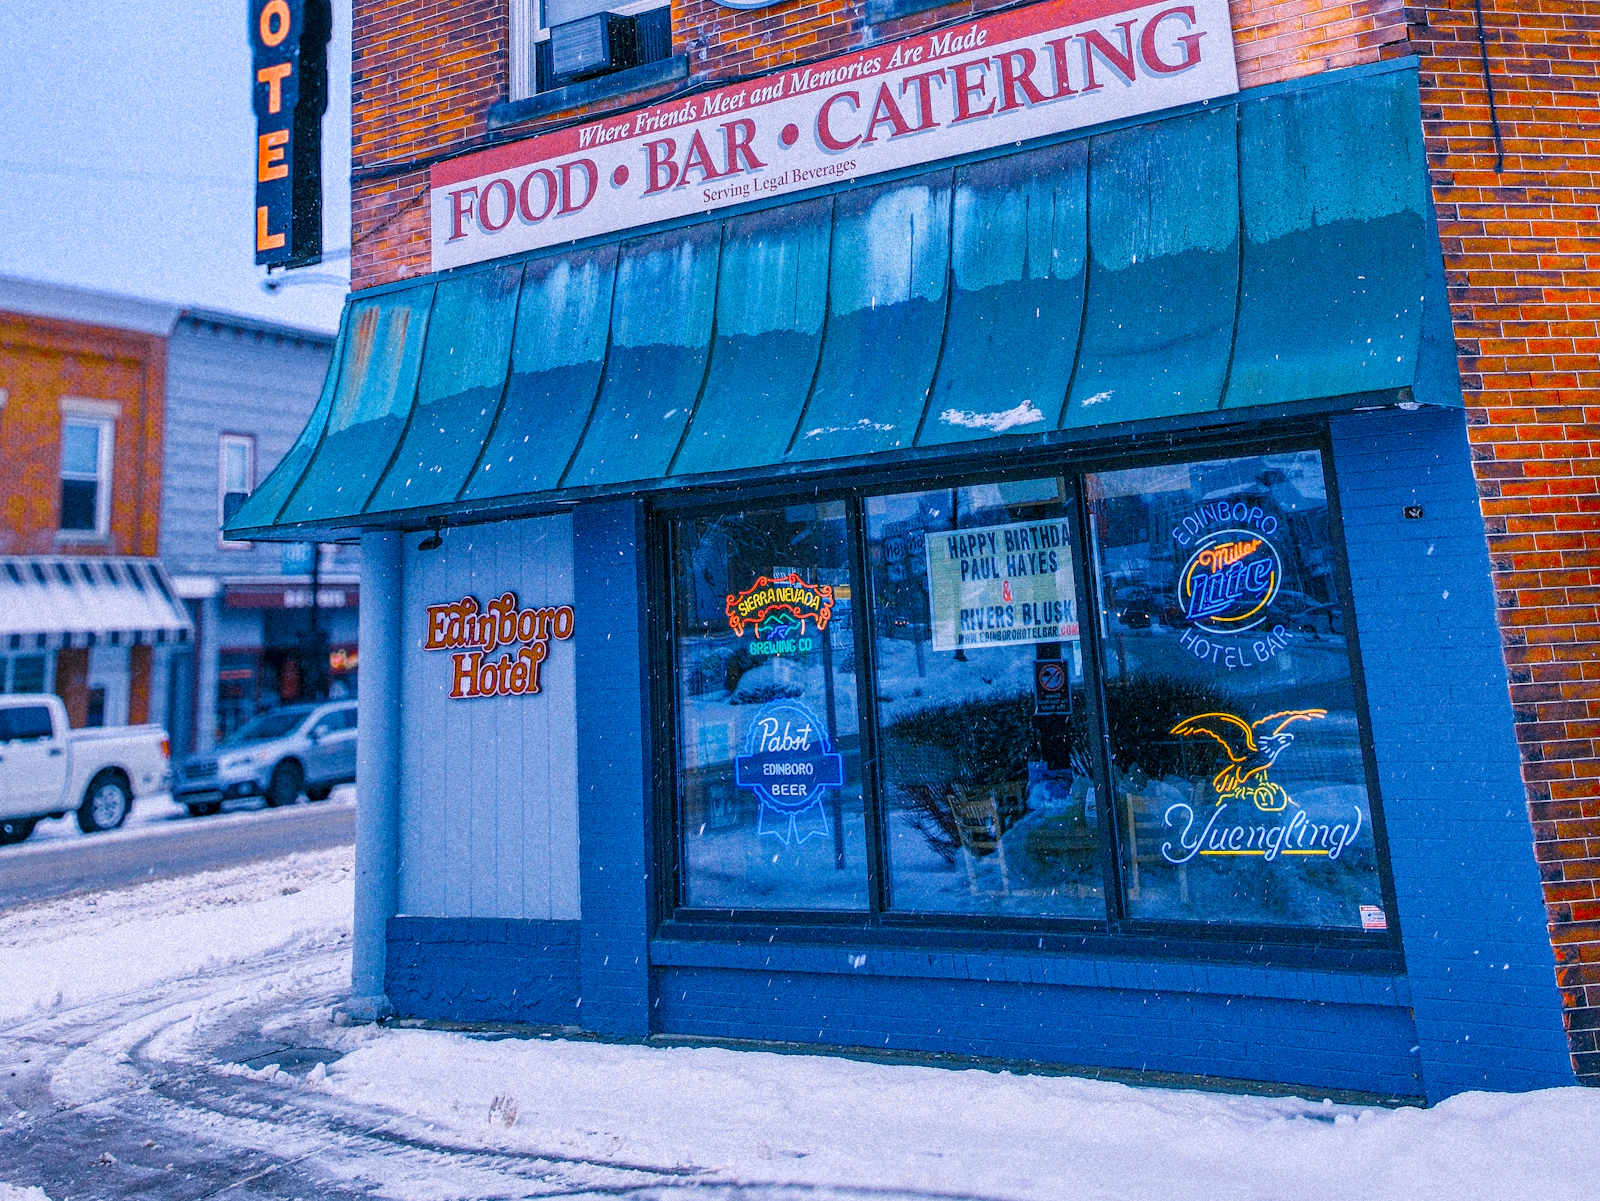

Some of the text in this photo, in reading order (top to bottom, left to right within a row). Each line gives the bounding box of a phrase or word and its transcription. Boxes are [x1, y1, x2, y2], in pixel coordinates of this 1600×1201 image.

[579, 24, 988, 149] Where Friends Meet and Memories Are Made
[446, 5, 1208, 243] FOOD BAR CATERING
[702, 158, 857, 204] Serving Legal Beverages
[1172, 502, 1278, 545] EDINBORO
[948, 532, 996, 559] HAPPY
[1198, 539, 1263, 574] Miller
[961, 551, 1058, 581] PAUL HAYES
[738, 587, 820, 616] SIERRA NEVADA
[1002, 580, 1012, 602] &
[424, 592, 575, 652] Edinboro
[961, 600, 1078, 631] RIVERS BLUSK
[1180, 624, 1293, 670] HOTEL BAR
[449, 641, 547, 699] Hotel
[758, 717, 812, 752] Pabst
[763, 763, 814, 775] EDINBORO
[772, 784, 807, 796] BEER
[1162, 803, 1362, 863] Yuengling
